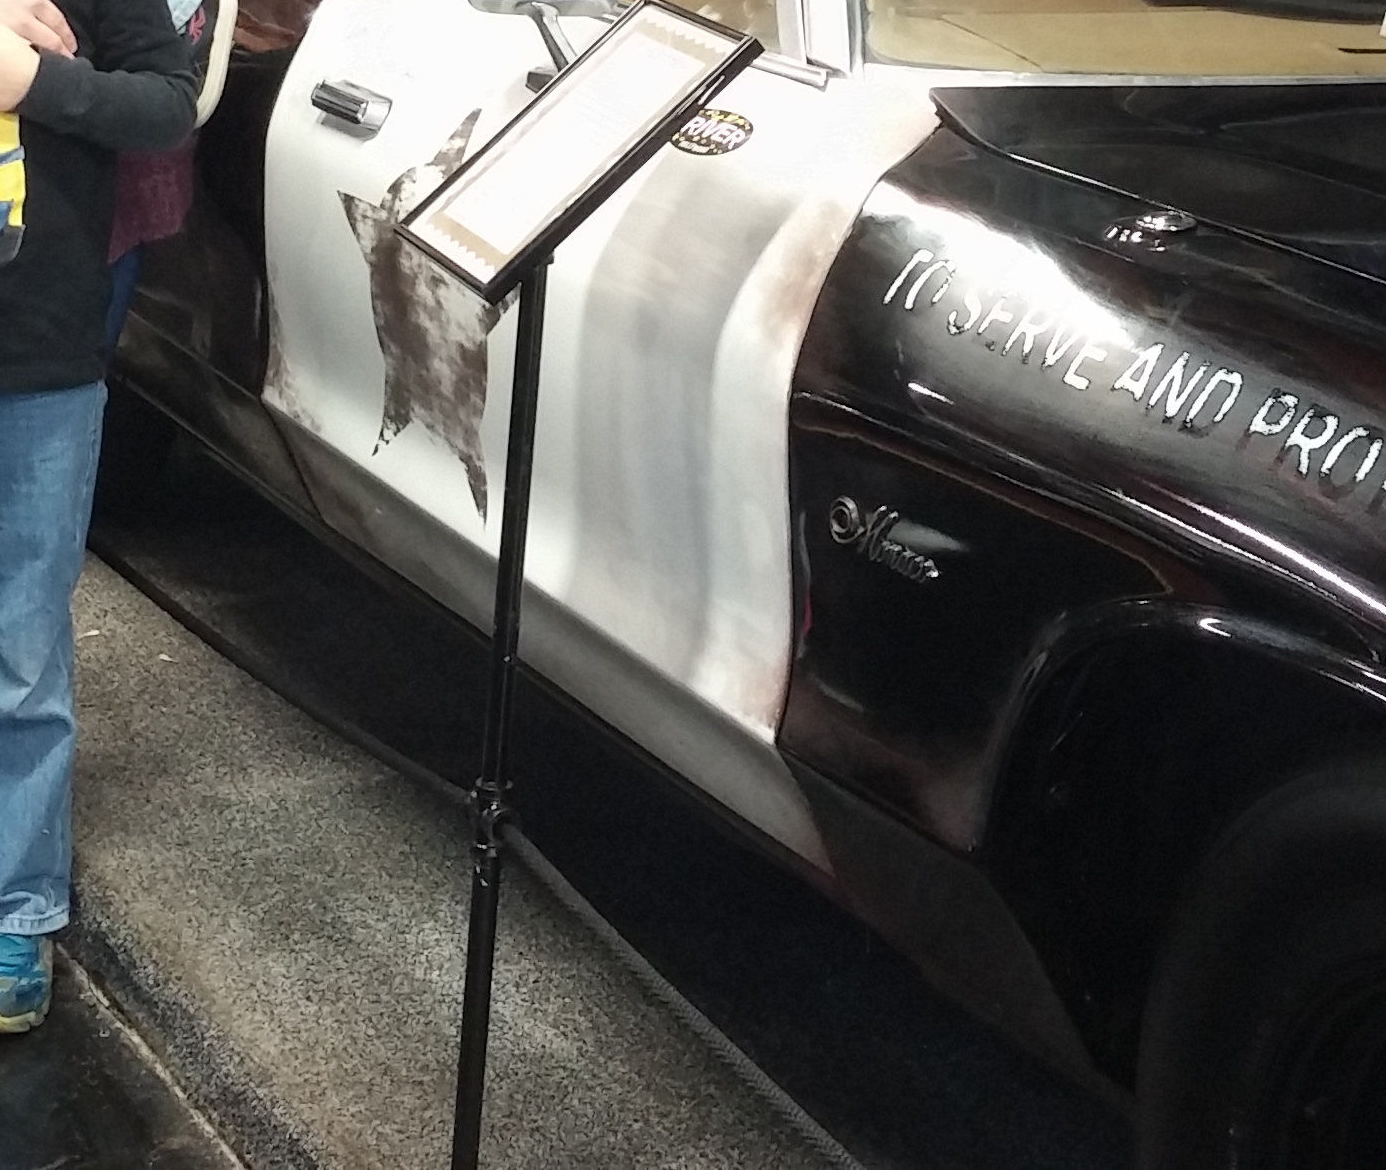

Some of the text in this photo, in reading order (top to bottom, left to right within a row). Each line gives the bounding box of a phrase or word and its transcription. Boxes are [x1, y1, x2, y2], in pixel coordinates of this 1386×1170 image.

[882, 249, 957, 311] TO
[947, 283, 1110, 390] SERVE
[1112, 341, 1244, 437] AND
